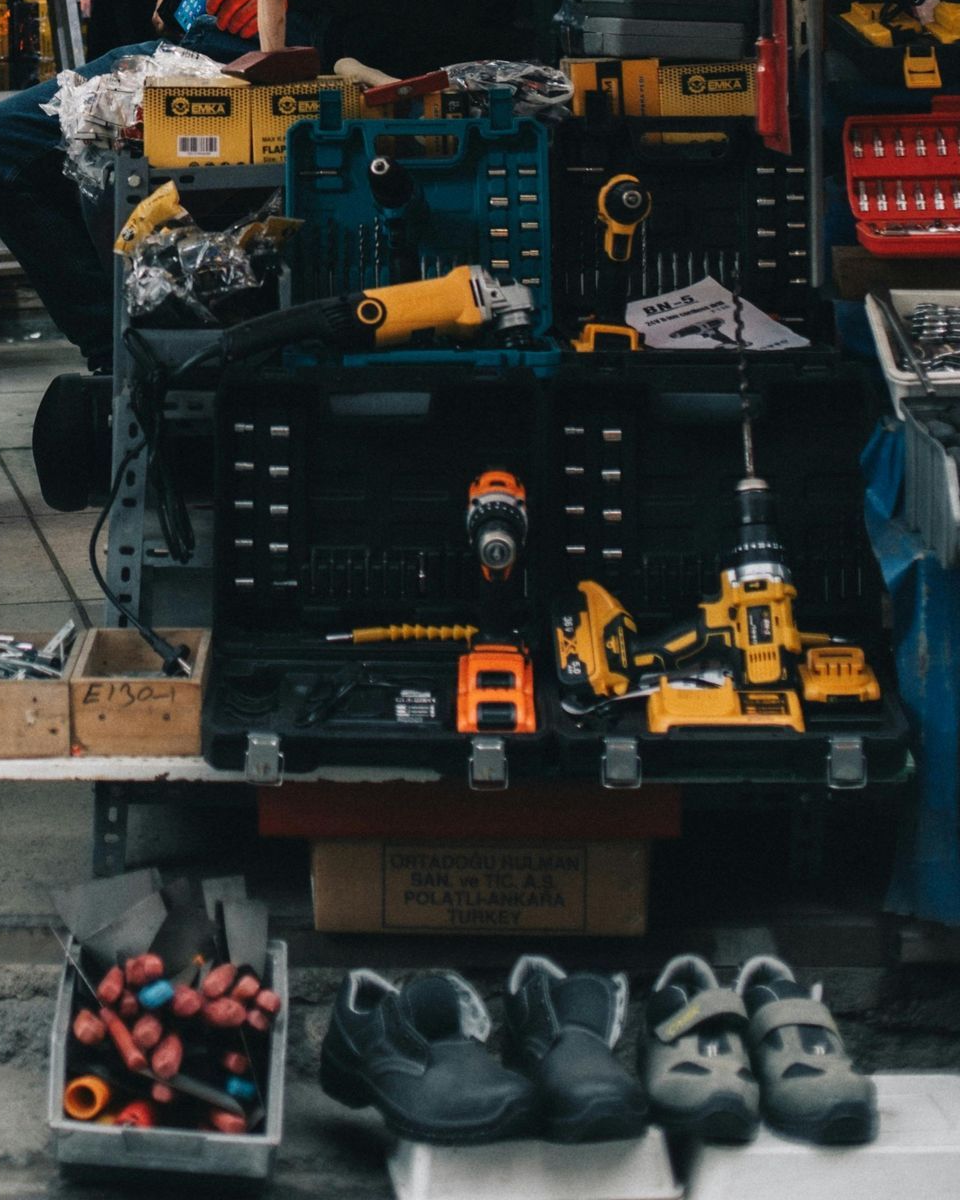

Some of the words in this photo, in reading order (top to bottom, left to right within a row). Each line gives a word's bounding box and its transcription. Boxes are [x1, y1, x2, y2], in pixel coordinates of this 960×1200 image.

[708, 78, 742, 91] EMKA
[191, 103, 225, 114] EMKA
[298, 102, 320, 112] EMK
[643, 294, 695, 315] BN-5
[459, 875, 479, 888] ve
